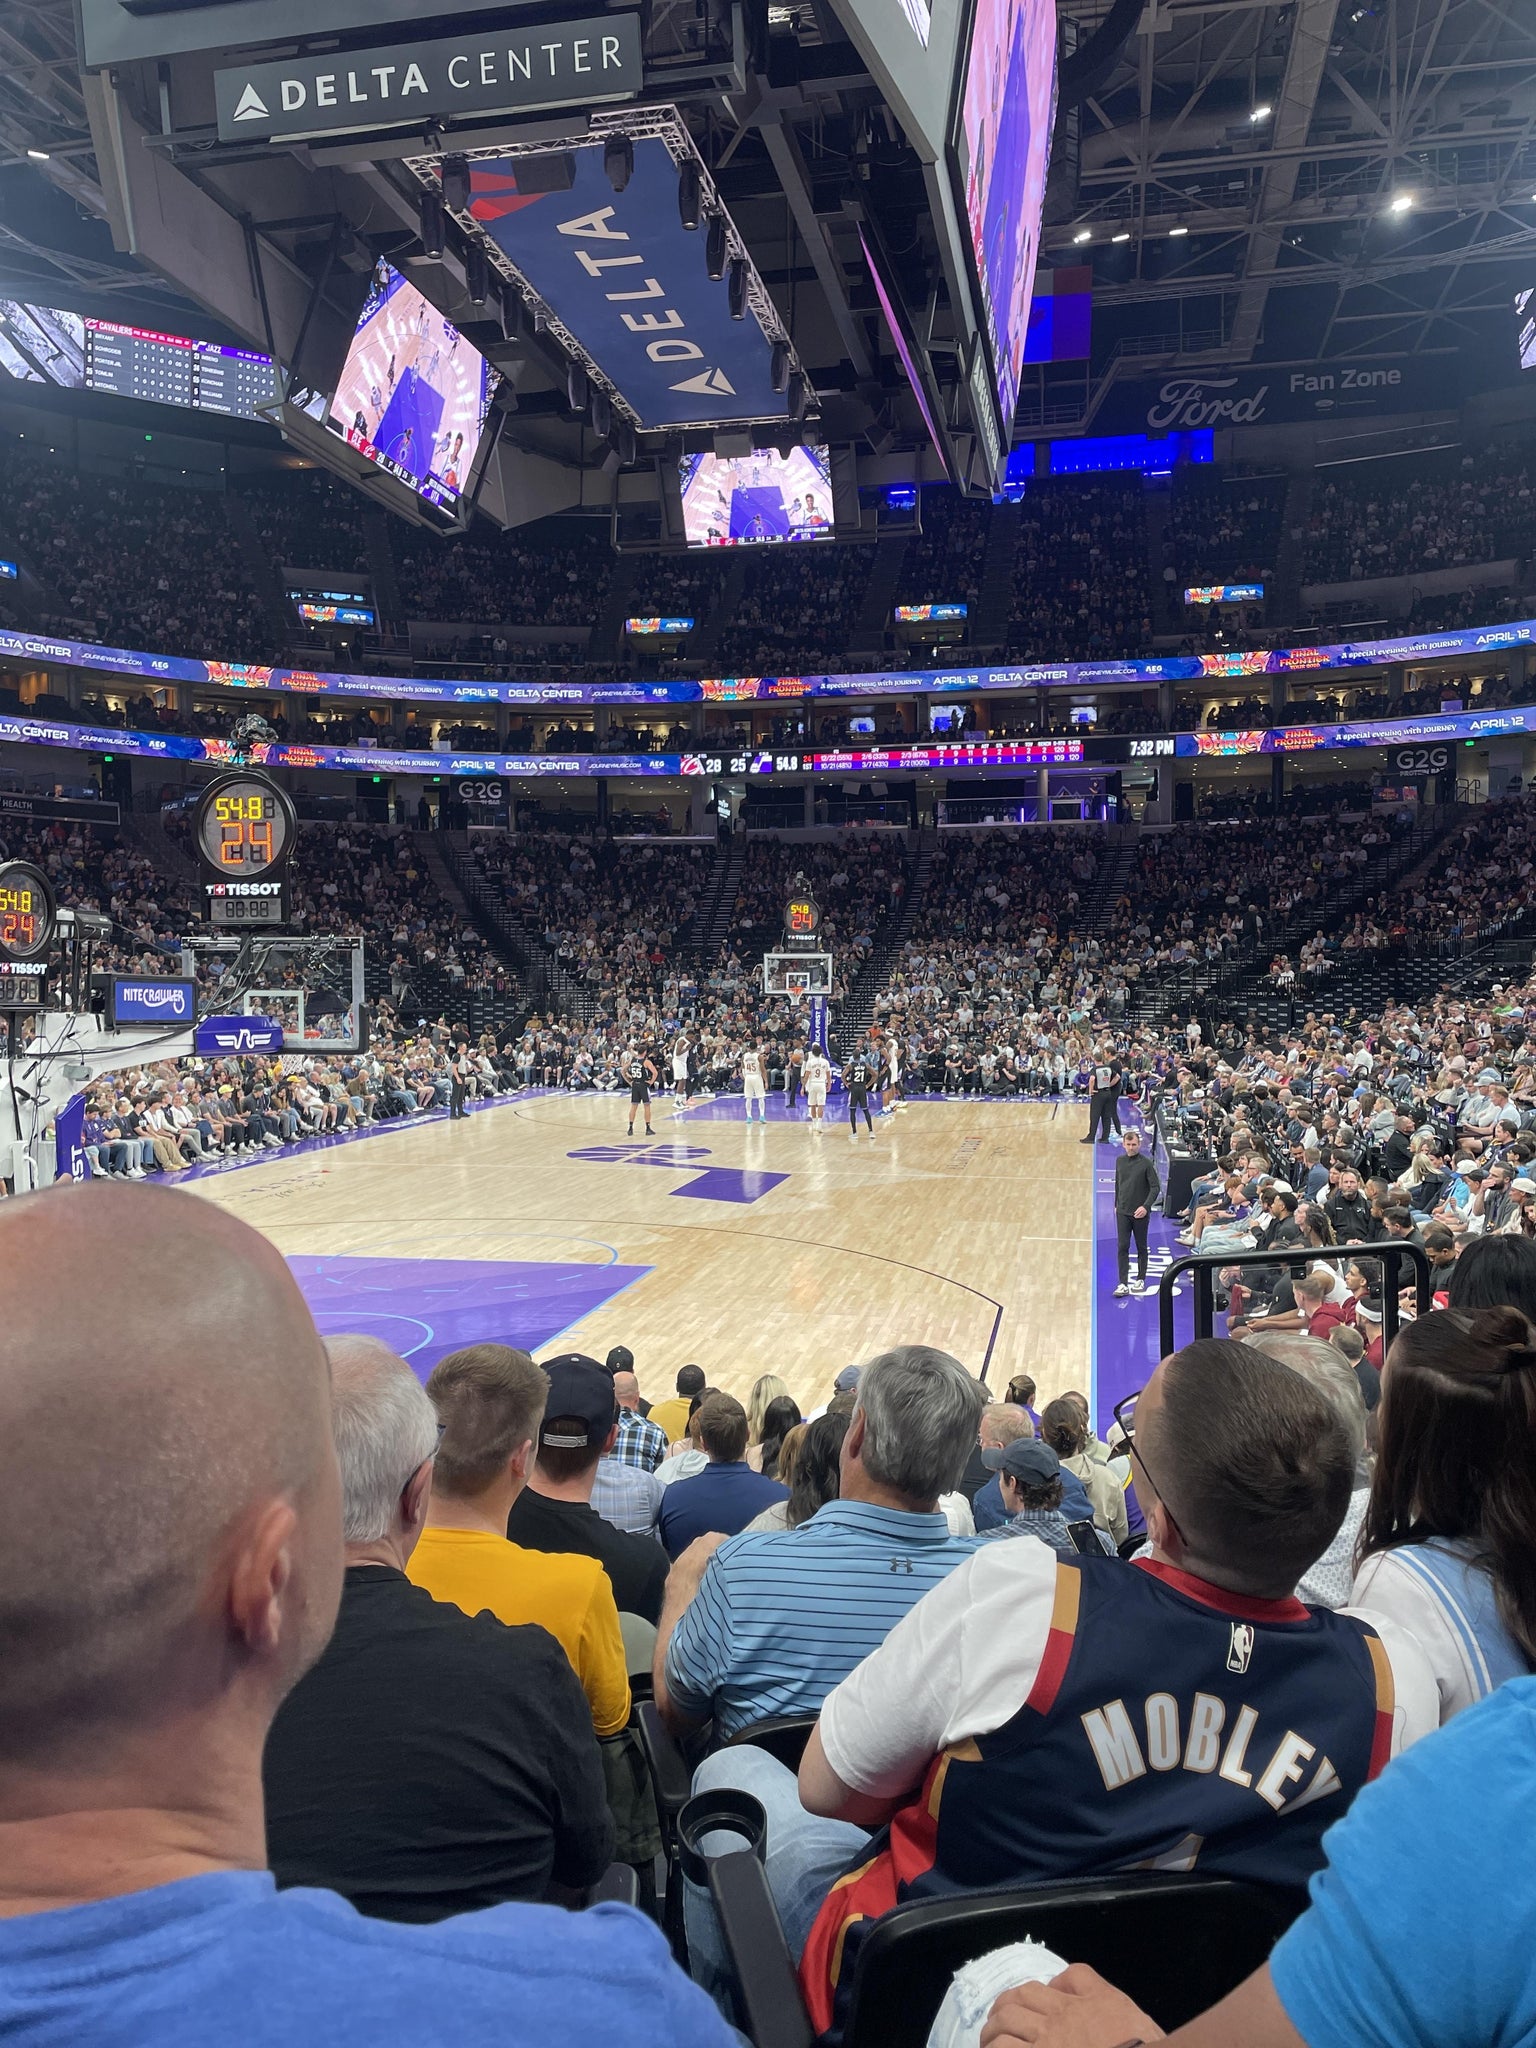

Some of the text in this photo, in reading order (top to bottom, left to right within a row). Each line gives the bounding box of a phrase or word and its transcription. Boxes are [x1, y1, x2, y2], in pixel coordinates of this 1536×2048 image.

[281, 36, 622, 111] DELTA CENTER
[556, 206, 704, 362] DELTA
[99, 322, 132, 336] CAVALIERS
[205, 344, 222, 354] JAZZ
[1290, 368, 1401, 393] Fan Zone
[1147, 377, 1269, 428] Ford
[1349, 649, 1376, 659] special
[1378, 646, 1408, 655] evening
[1409, 643, 1428, 651] with
[1429, 639, 1463, 650] JOURNEY
[1476, 632, 1515, 645] APRIL
[1517, 629, 1530, 639] 12
[25, 641, 169, 669] CENTER JOURNEYMUSIC.COM AEG
[1280, 654, 1330, 667] FRONTIER
[1290, 649, 1319, 658] FINAL
[1202, 652, 1272, 676] JOURNEY
[291, 671, 318, 681] FINAL
[989, 665, 1162, 682] DELTA CENTER JOURNEYMUSIC.COM AEG
[281, 678, 328, 689] FRONTIER
[344, 682, 369, 690] special
[370, 684, 396, 692] evening
[454, 688, 486, 697] APRIL
[487, 689, 499, 697] 12
[769, 684, 811, 694] FRONTIER
[777, 679, 802, 687] FINAL
[826, 682, 850, 690] special
[877, 679, 893, 687] with
[933, 676, 966, 685] APRIL
[967, 675, 978, 684] 12
[508, 689, 540, 698] DELTA
[542, 689, 582, 698] CENTER
[1285, 730, 1314, 739] FINAL
[1343, 731, 1370, 741] special
[1372, 729, 1402, 738] evening
[1403, 727, 1422, 735] with
[1423, 724, 1457, 734] JOURNEY
[1470, 719, 1509, 730] APRIL
[1511, 716, 1524, 726] 12
[22, 726, 69, 740] CENTER
[79, 735, 139, 747] JOURNEYMUSIC.COM
[1274, 735, 1325, 748] FRONTIER
[288, 746, 315, 756] FINAL
[1130, 739, 1174, 756] 7:32 PM
[1198, 732, 1266, 756] JOURNEY
[279, 753, 325, 764] FRONTIER
[341, 757, 366, 765] special
[451, 761, 483, 769] APRIL
[484, 761, 495, 769] 12
[505, 761, 537, 770] DELTA
[539, 761, 579, 770] CENTER
[706, 756, 797, 772] 28 25 54.8
[1397, 748, 1447, 769] G2G
[459, 781, 502, 798] G2G
[3, 800, 33, 809] HEALTH
[215, 797, 262, 820] 54.8
[220, 822, 273, 864] 24
[226, 883, 281, 897] TISSOT
[0, 889, 31, 913] 54.8
[791, 905, 809, 914] 54.8
[4, 914, 34, 943] 24
[792, 914, 812, 929] 24
[10, 963, 47, 975] TISSOT
[124, 988, 185, 1014] NITECRAWLER
[631, 1068, 642, 1078] 55
[746, 1063, 756, 1072] 45
[815, 1069, 820, 1078] 9
[854, 1071, 865, 1082] 21
[1230, 1659, 1241, 1670] NBA
[1080, 1691, 1343, 1817] MOBLEY
